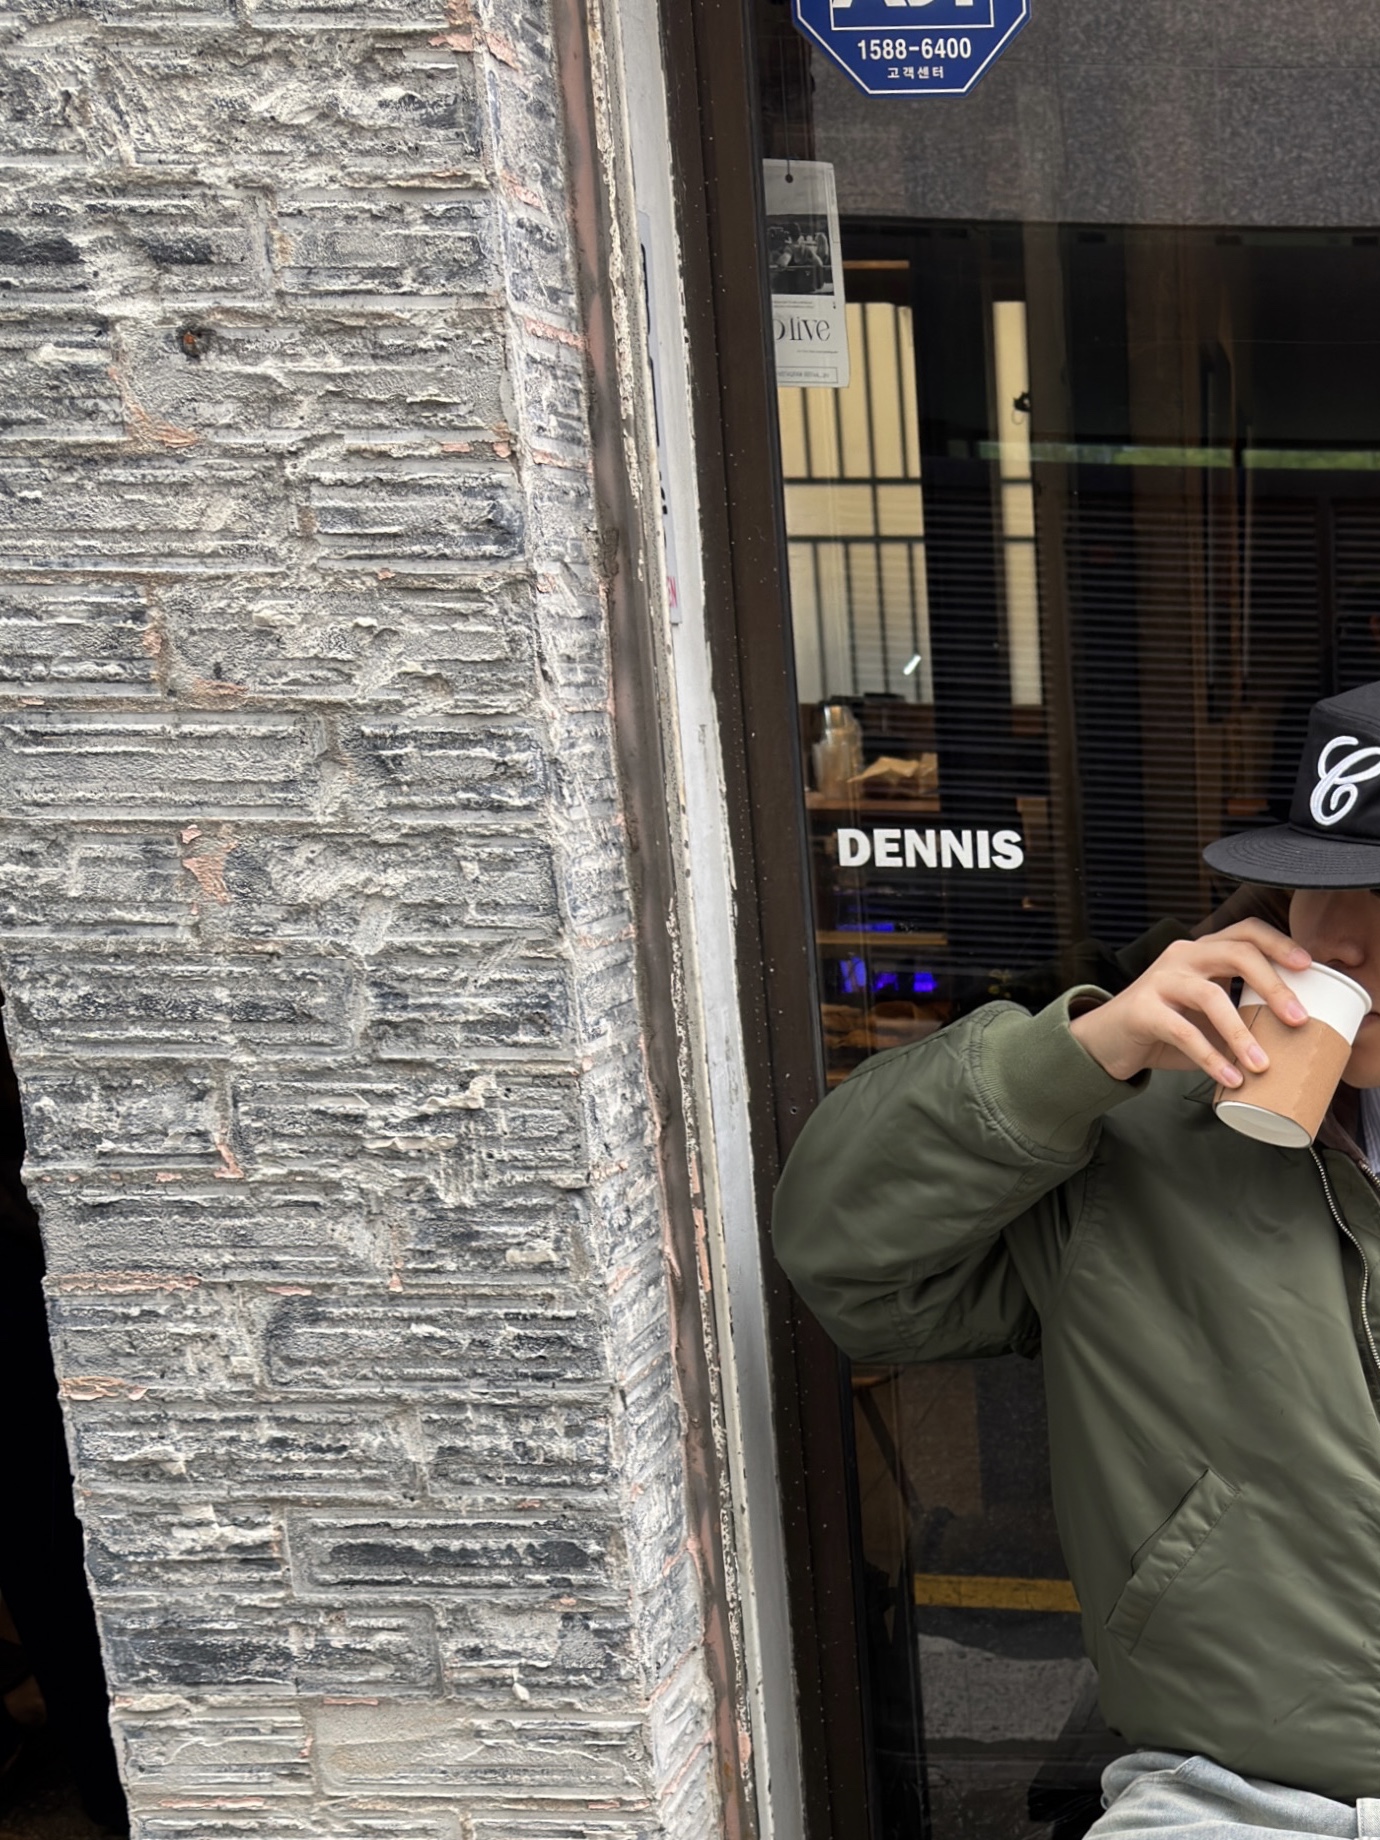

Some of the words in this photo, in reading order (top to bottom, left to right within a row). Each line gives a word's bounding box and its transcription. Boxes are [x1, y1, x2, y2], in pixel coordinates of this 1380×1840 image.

[857, 37, 972, 60] 1588-6400
[887, 66, 945, 80] 고객센터
[837, 827, 1025, 871] DENNIS
